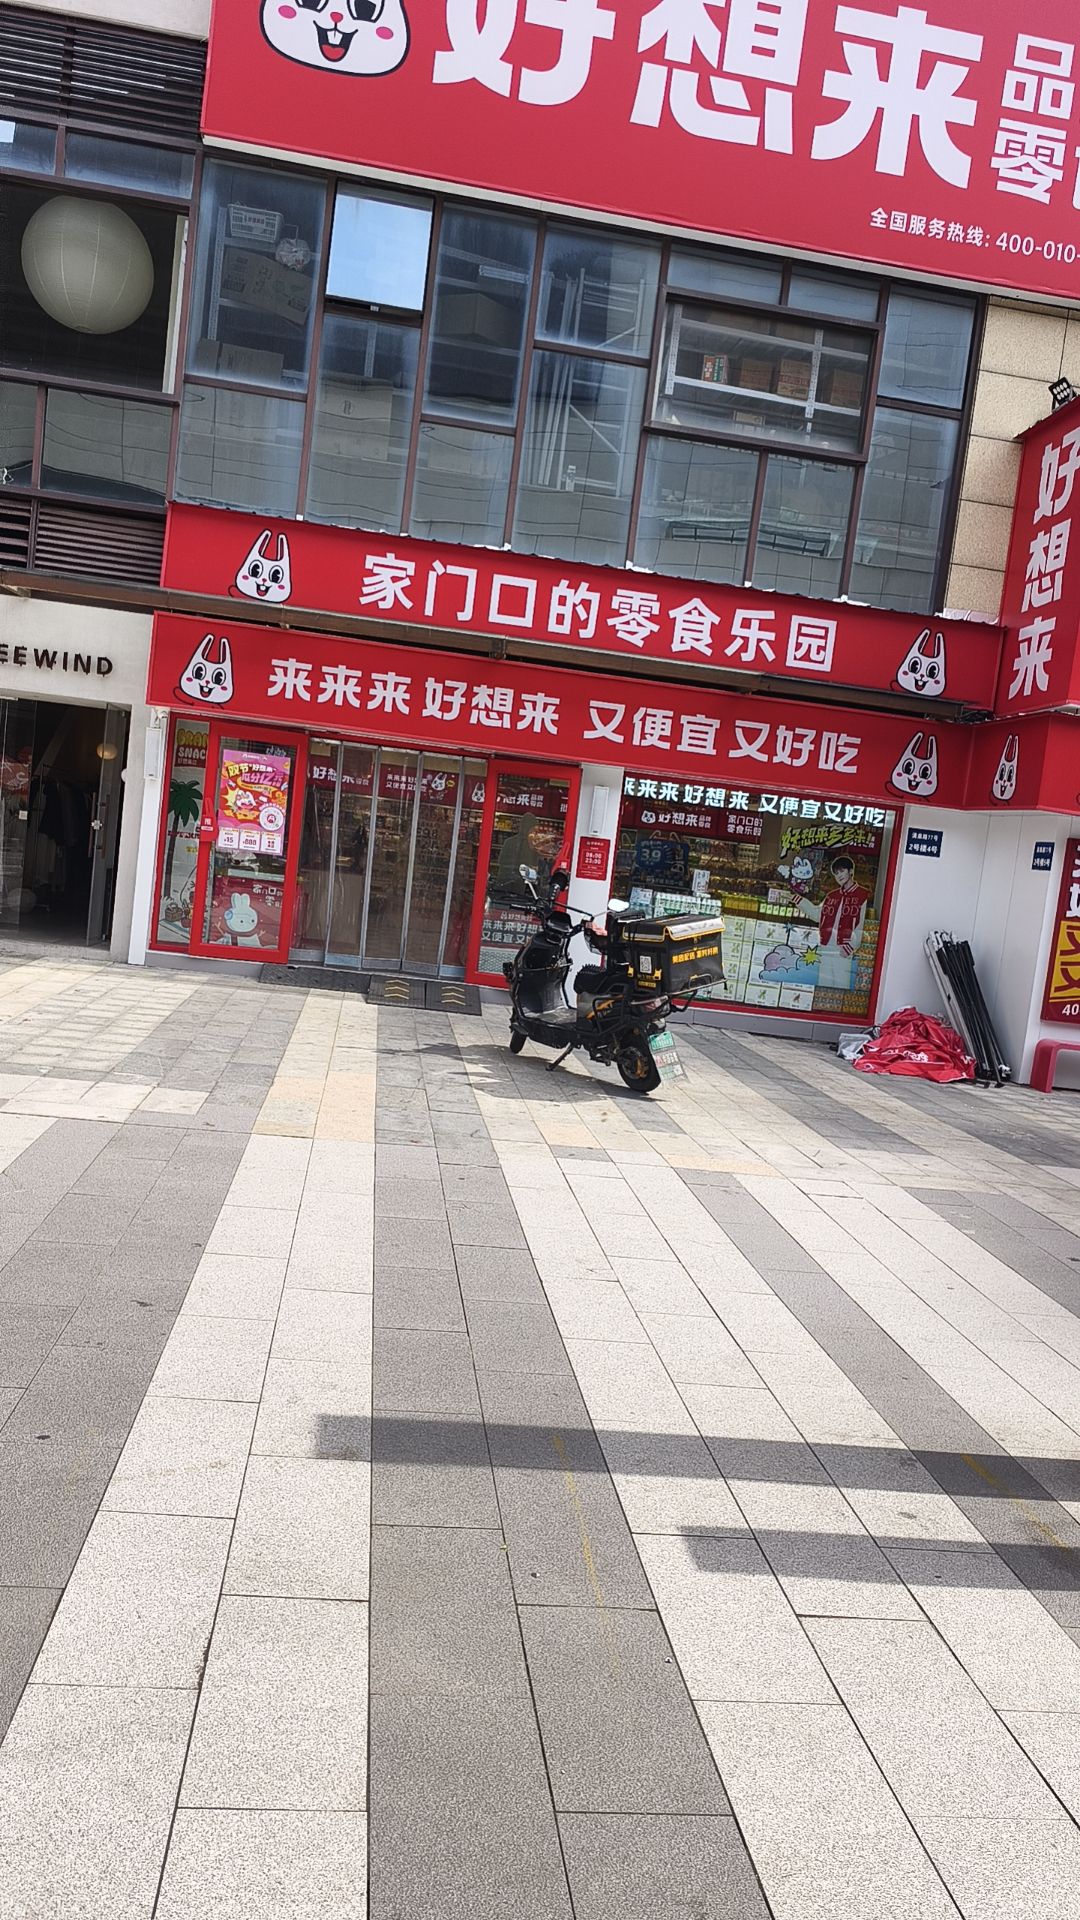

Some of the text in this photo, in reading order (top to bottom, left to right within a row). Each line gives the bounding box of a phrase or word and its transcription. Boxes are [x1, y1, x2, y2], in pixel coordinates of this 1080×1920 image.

[359, 552, 838, 673] 家门口的零食乐园
